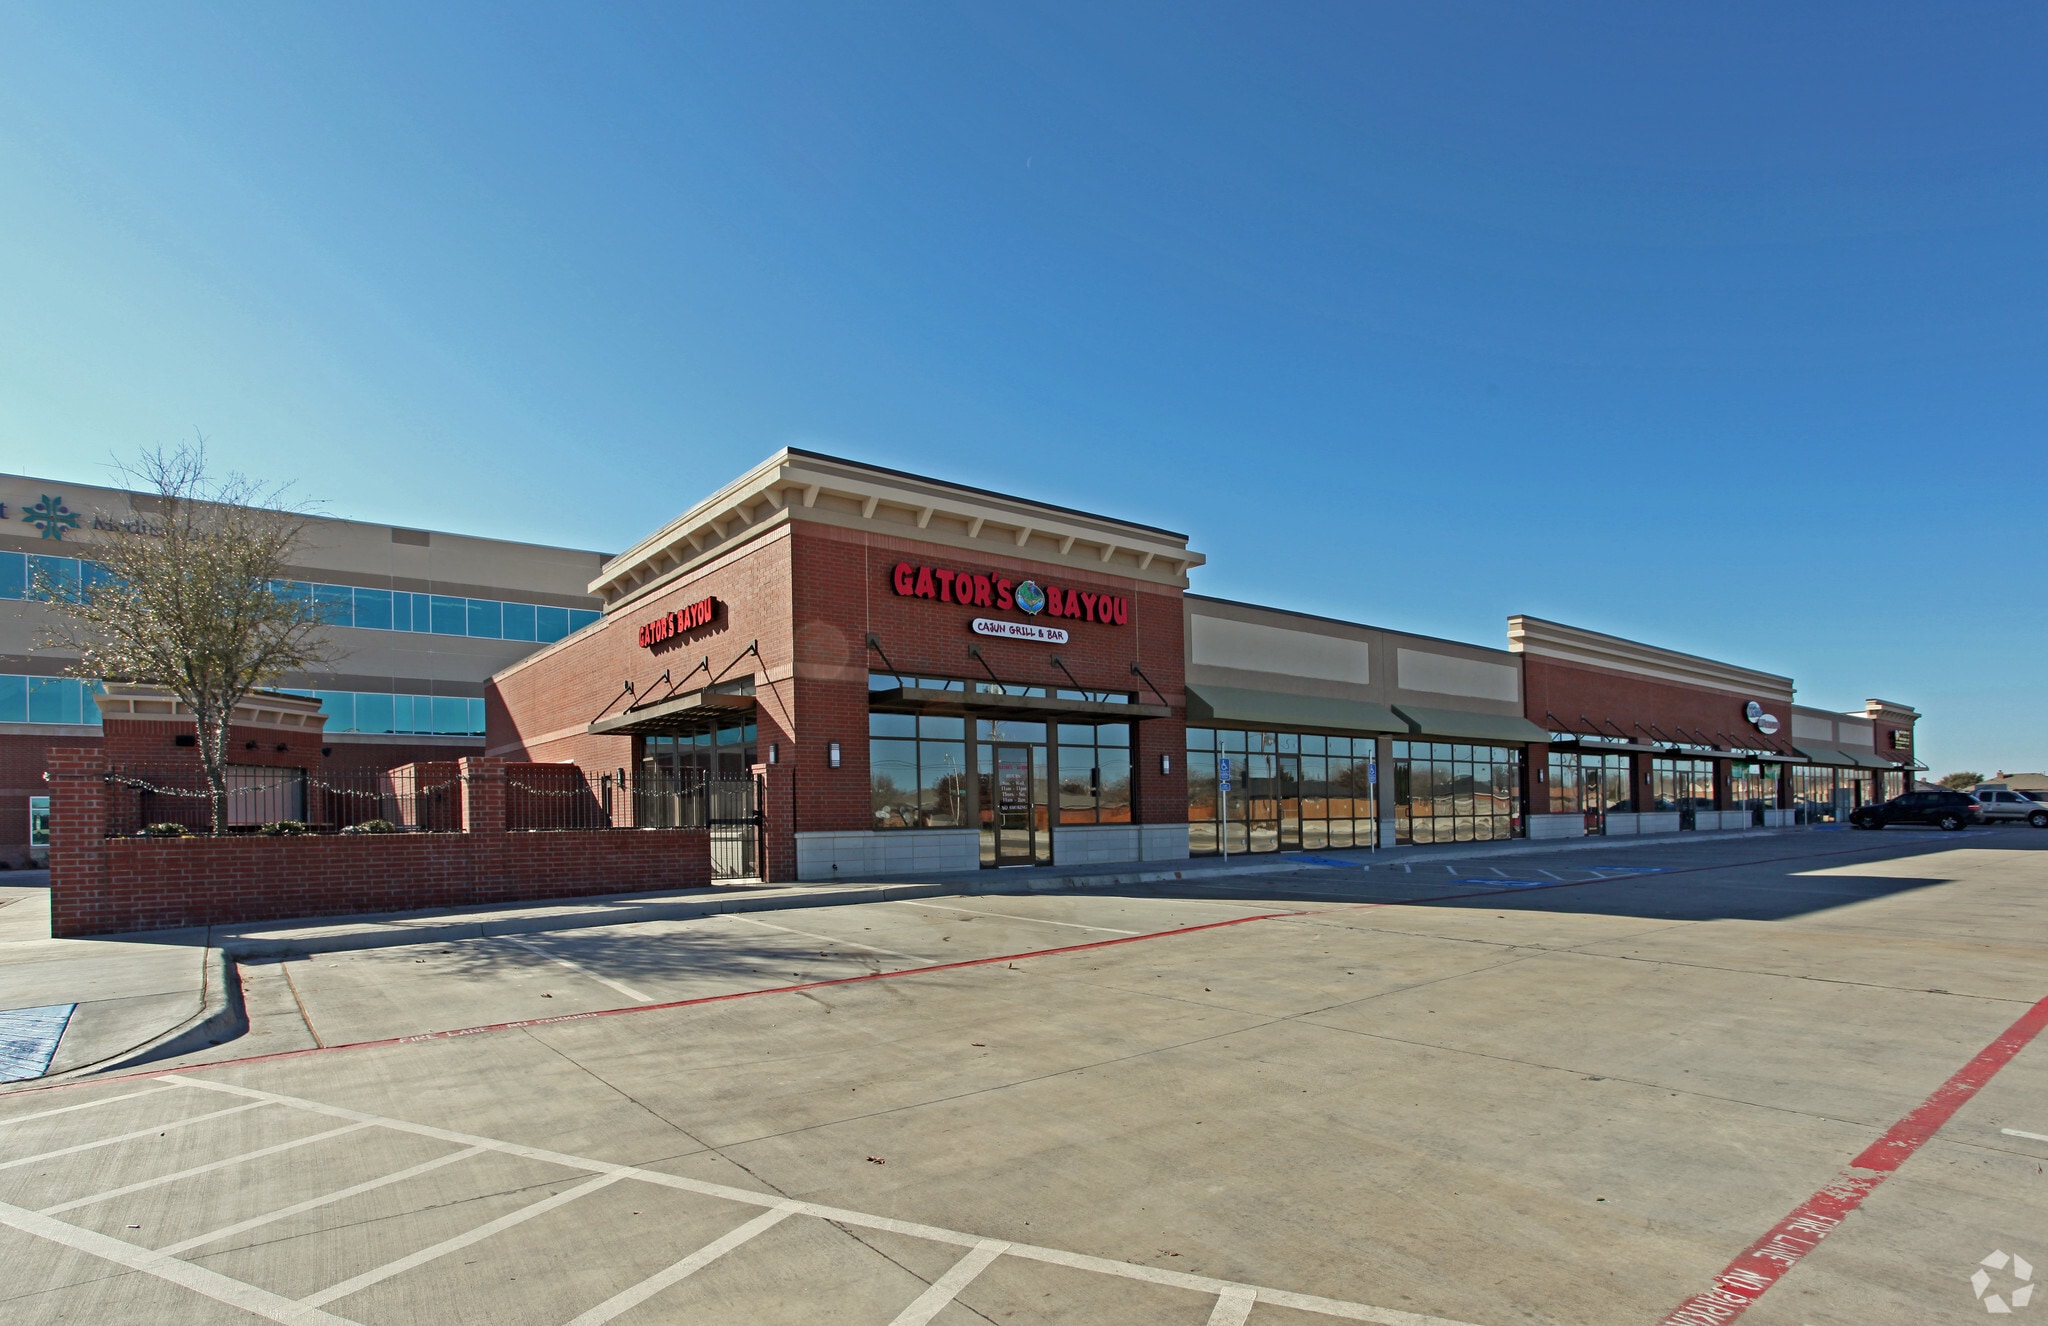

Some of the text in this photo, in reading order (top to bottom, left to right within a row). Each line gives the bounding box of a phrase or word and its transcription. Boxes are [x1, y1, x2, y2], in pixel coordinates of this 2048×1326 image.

[894, 562, 1128, 625] GATOR'S BAYOU
[638, 597, 713, 647] GATOR'S BAYOU
[977, 622, 1064, 640] CAJUN GRILL & BAR
[1784, 1210, 1841, 1239] FIRE
[1752, 1233, 1816, 1266] LANE
[1721, 1267, 1773, 1291] NO
